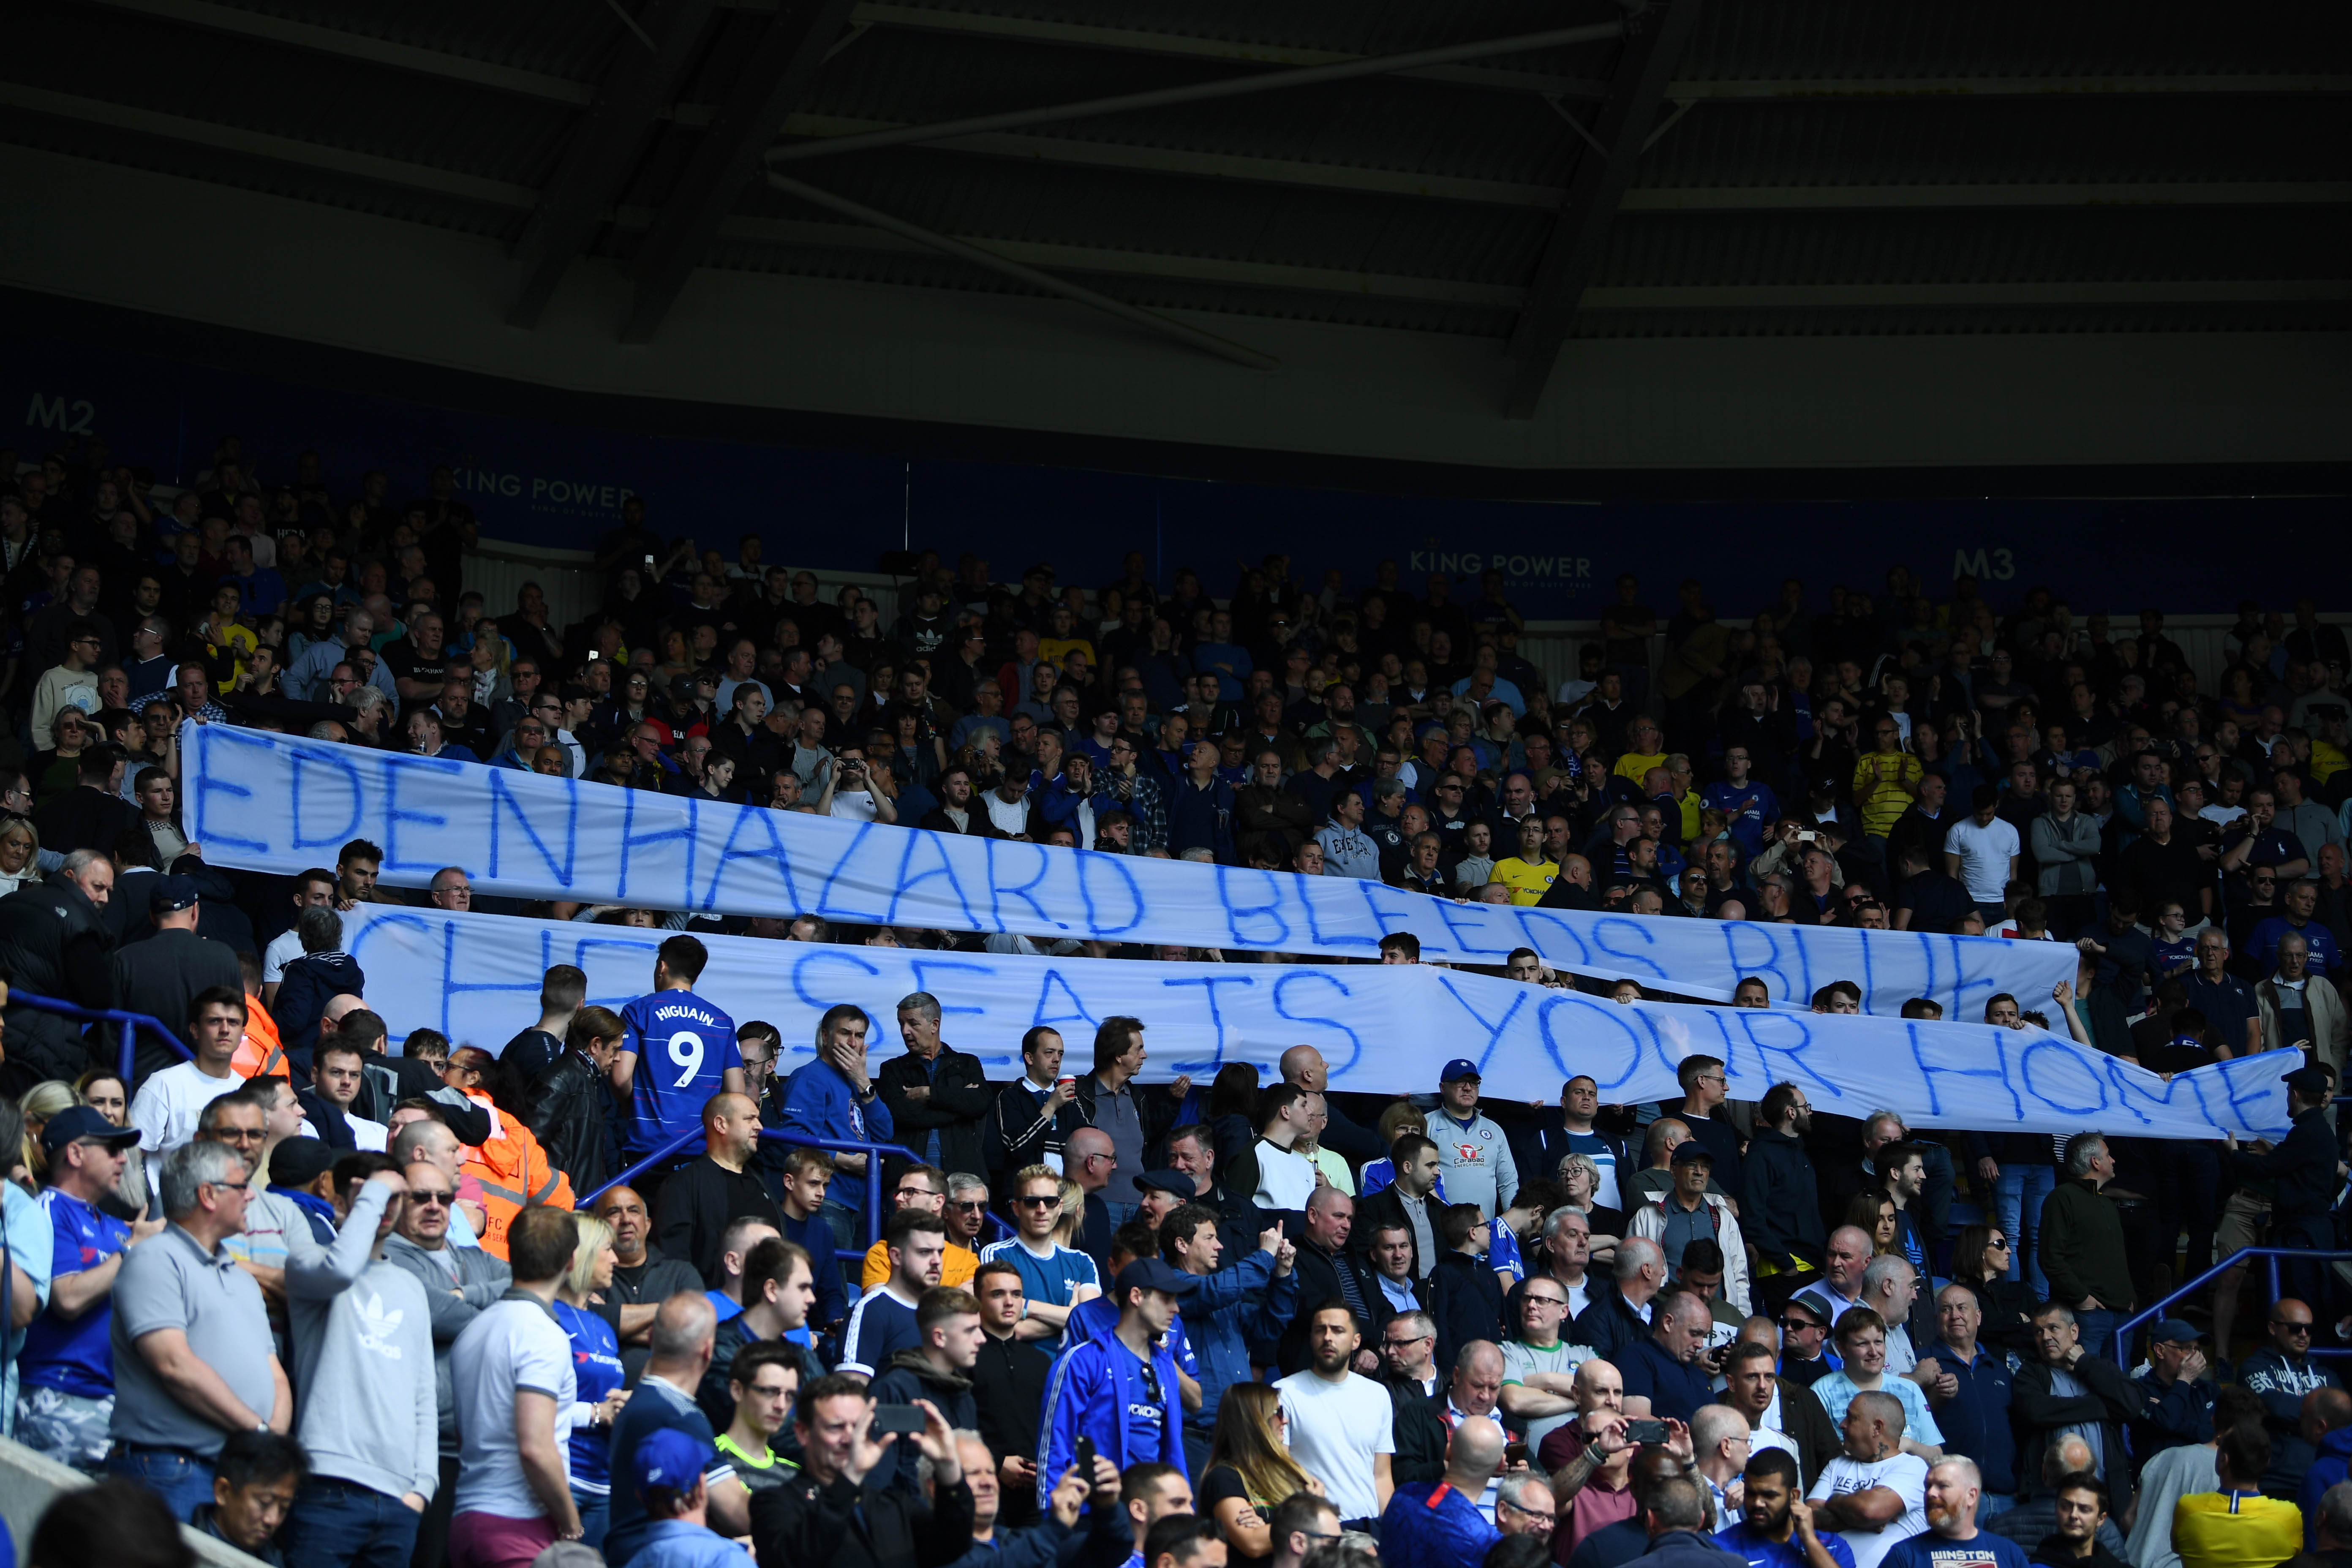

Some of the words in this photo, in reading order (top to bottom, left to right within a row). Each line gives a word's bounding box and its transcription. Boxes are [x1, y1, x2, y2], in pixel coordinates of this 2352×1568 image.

[26, 392, 95, 436] M2
[452, 467, 521, 497] KING
[1410, 550, 1482, 574] KING
[1492, 555, 1591, 578] POWER
[1953, 547, 2015, 581] M3
[195, 724, 577, 887] EDEN
[617, 787, 1144, 934] HAZARD
[1216, 864, 1669, 980] BLEEDS
[350, 913, 1100, 1065] CHESEA
[1162, 970, 1361, 1079] IS
[1438, 975, 1842, 1097] YOUR
[1906, 1023, 2298, 1134] HOME
[655, 1005, 714, 1026] HIGUAIN
[667, 1031, 705, 1088] 9
[488, 1217, 503, 1230] FC
[1930, 1550, 1996, 1561] WINSTON
